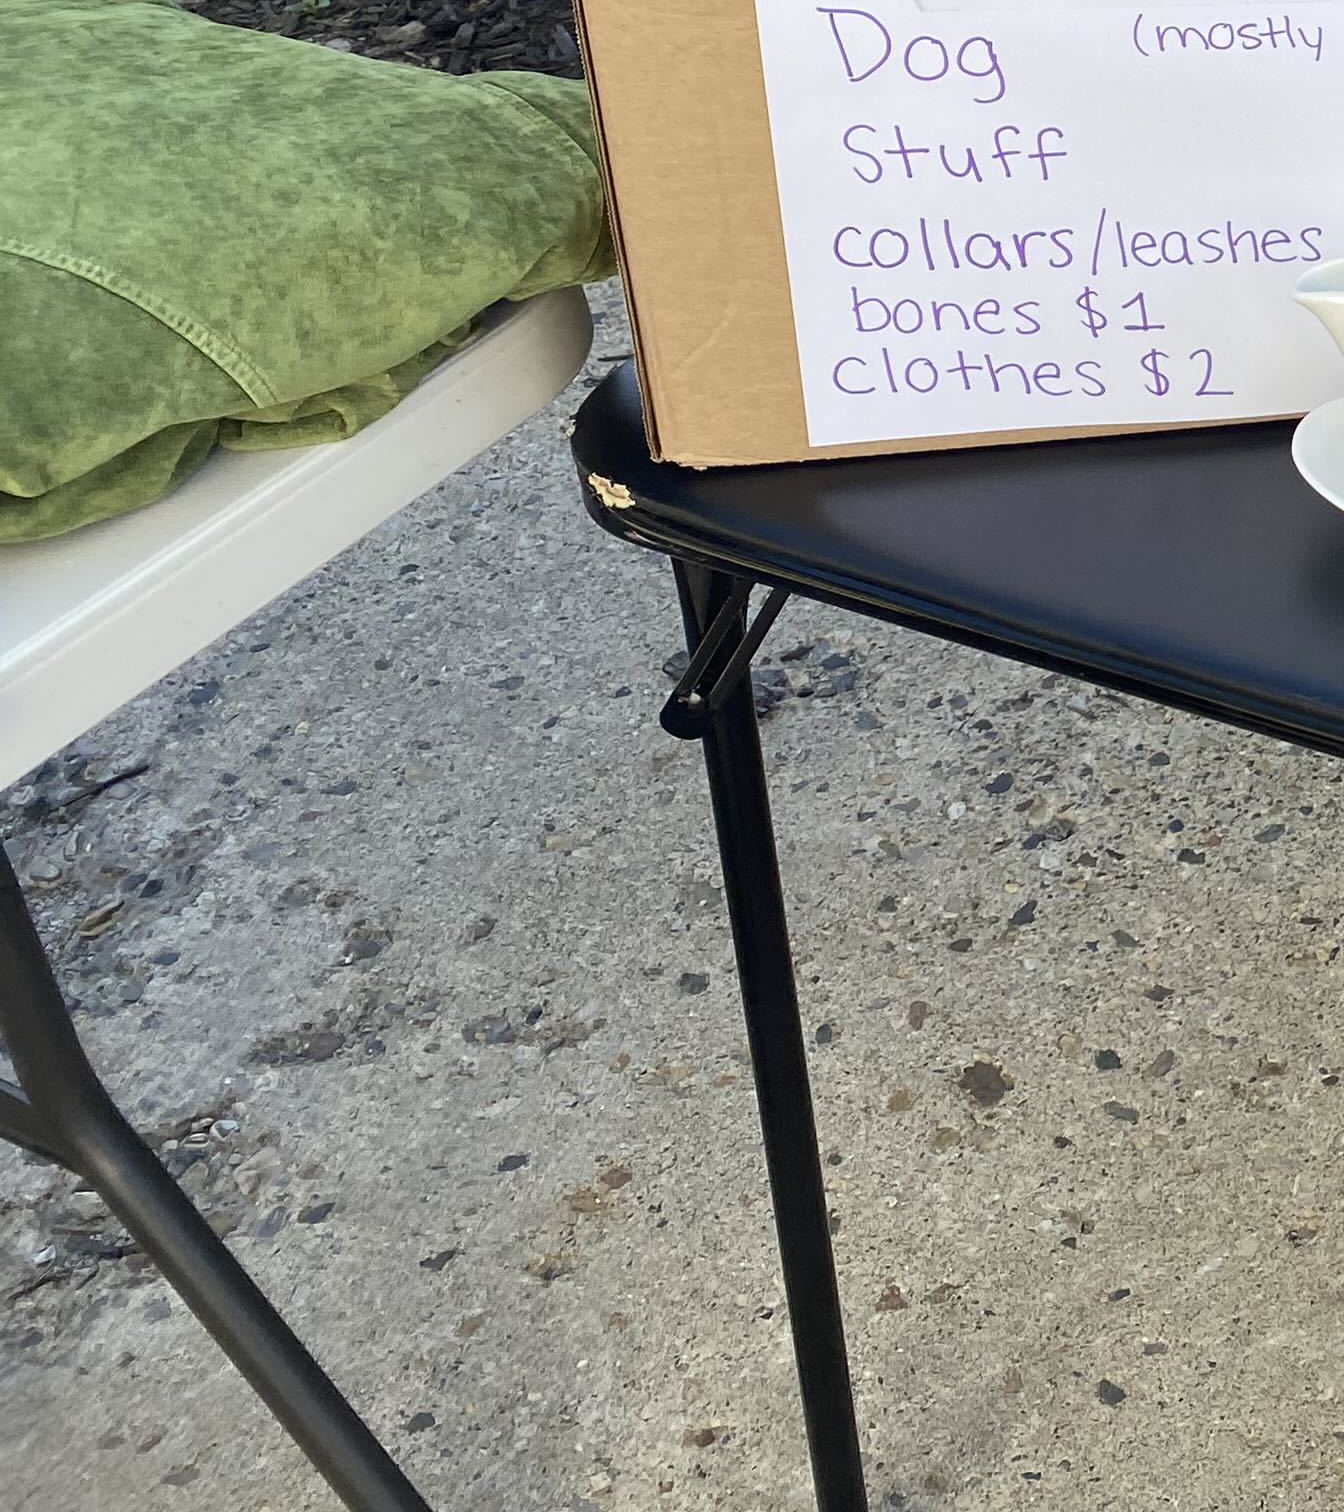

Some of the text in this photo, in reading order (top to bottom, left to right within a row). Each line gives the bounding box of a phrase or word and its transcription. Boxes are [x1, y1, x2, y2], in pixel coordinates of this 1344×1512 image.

[815, 5, 1010, 104] Dog
[1131, 10, 1326, 62] (mostly
[842, 120, 1070, 185] Stuff
[832, 206, 1327, 277] collars/leashes
[851, 286, 1168, 340] bones $1
[831, 344, 1237, 400] clothes $2
